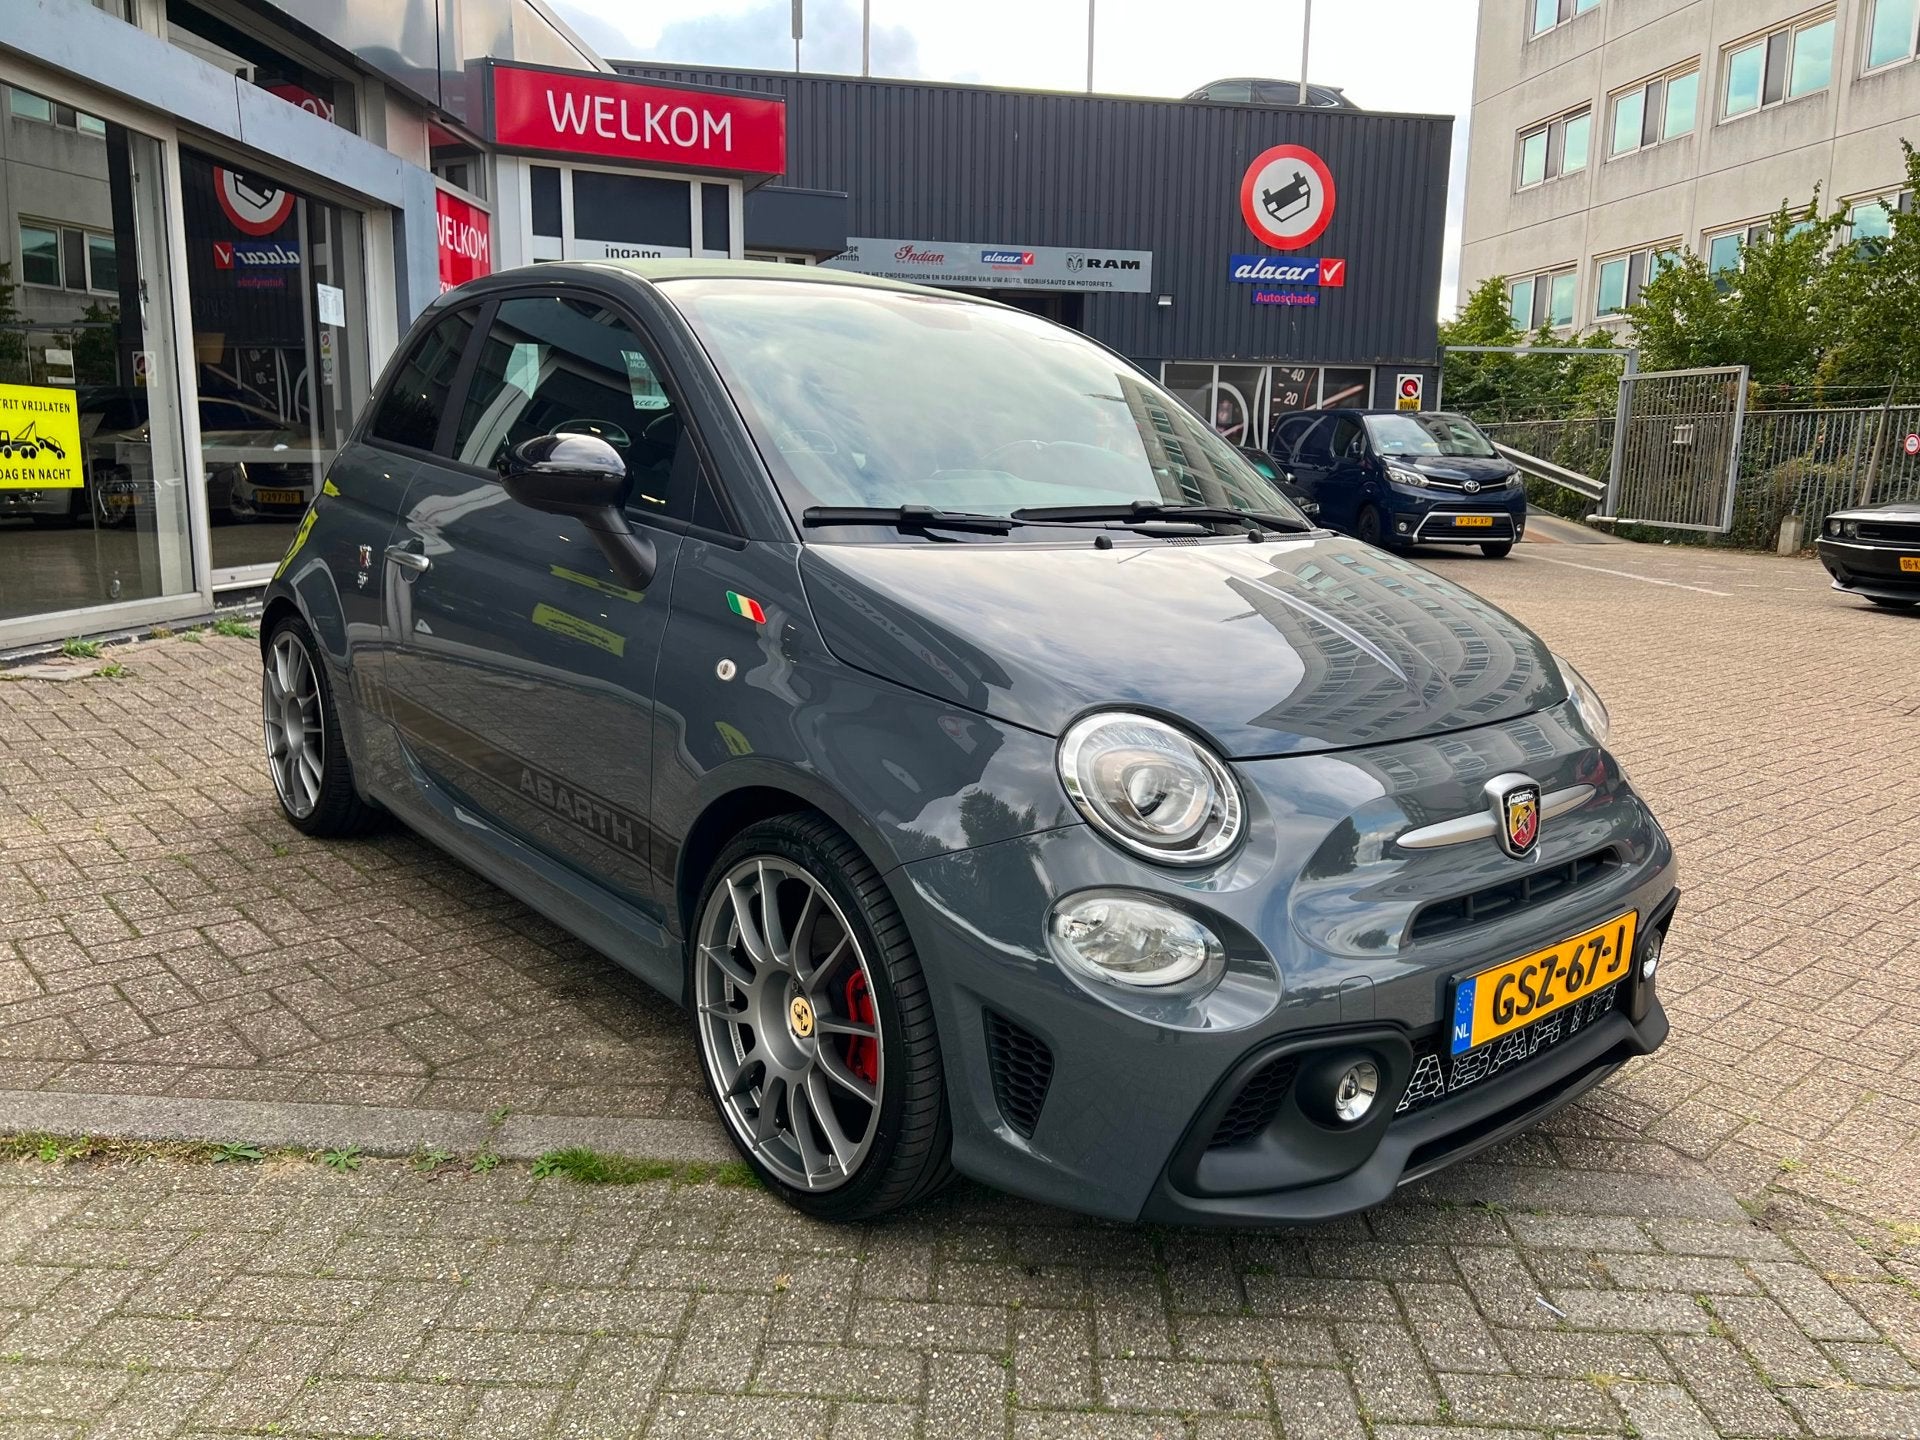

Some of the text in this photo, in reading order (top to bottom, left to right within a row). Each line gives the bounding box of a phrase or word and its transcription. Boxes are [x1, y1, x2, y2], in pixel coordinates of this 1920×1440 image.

[546, 89, 732, 152] WELKOM
[894, 244, 945, 264] Indian
[983, 251, 1022, 264] alacar
[1087, 258, 1141, 271] RAM
[1234, 257, 1317, 281] alacar
[884, 272, 931, 280] ONDERHOUDEN
[941, 274, 977, 282] REPAREREN
[978, 275, 991, 283] VAN
[1023, 278, 1067, 286] BEDRIJFSAUTO
[1255, 292, 1317, 305] Autoschade
[1290, 368, 1306, 382] 40
[1283, 391, 1299, 406] 20
[22, 401, 71, 413] VRIJLATEN
[22, 468, 35, 480] EN
[39, 468, 72, 481] NACHT
[519, 767, 634, 850] ABARTH
[1491, 923, 1627, 1026] GSZ-67-J
[1454, 1023, 1470, 1041] NL
